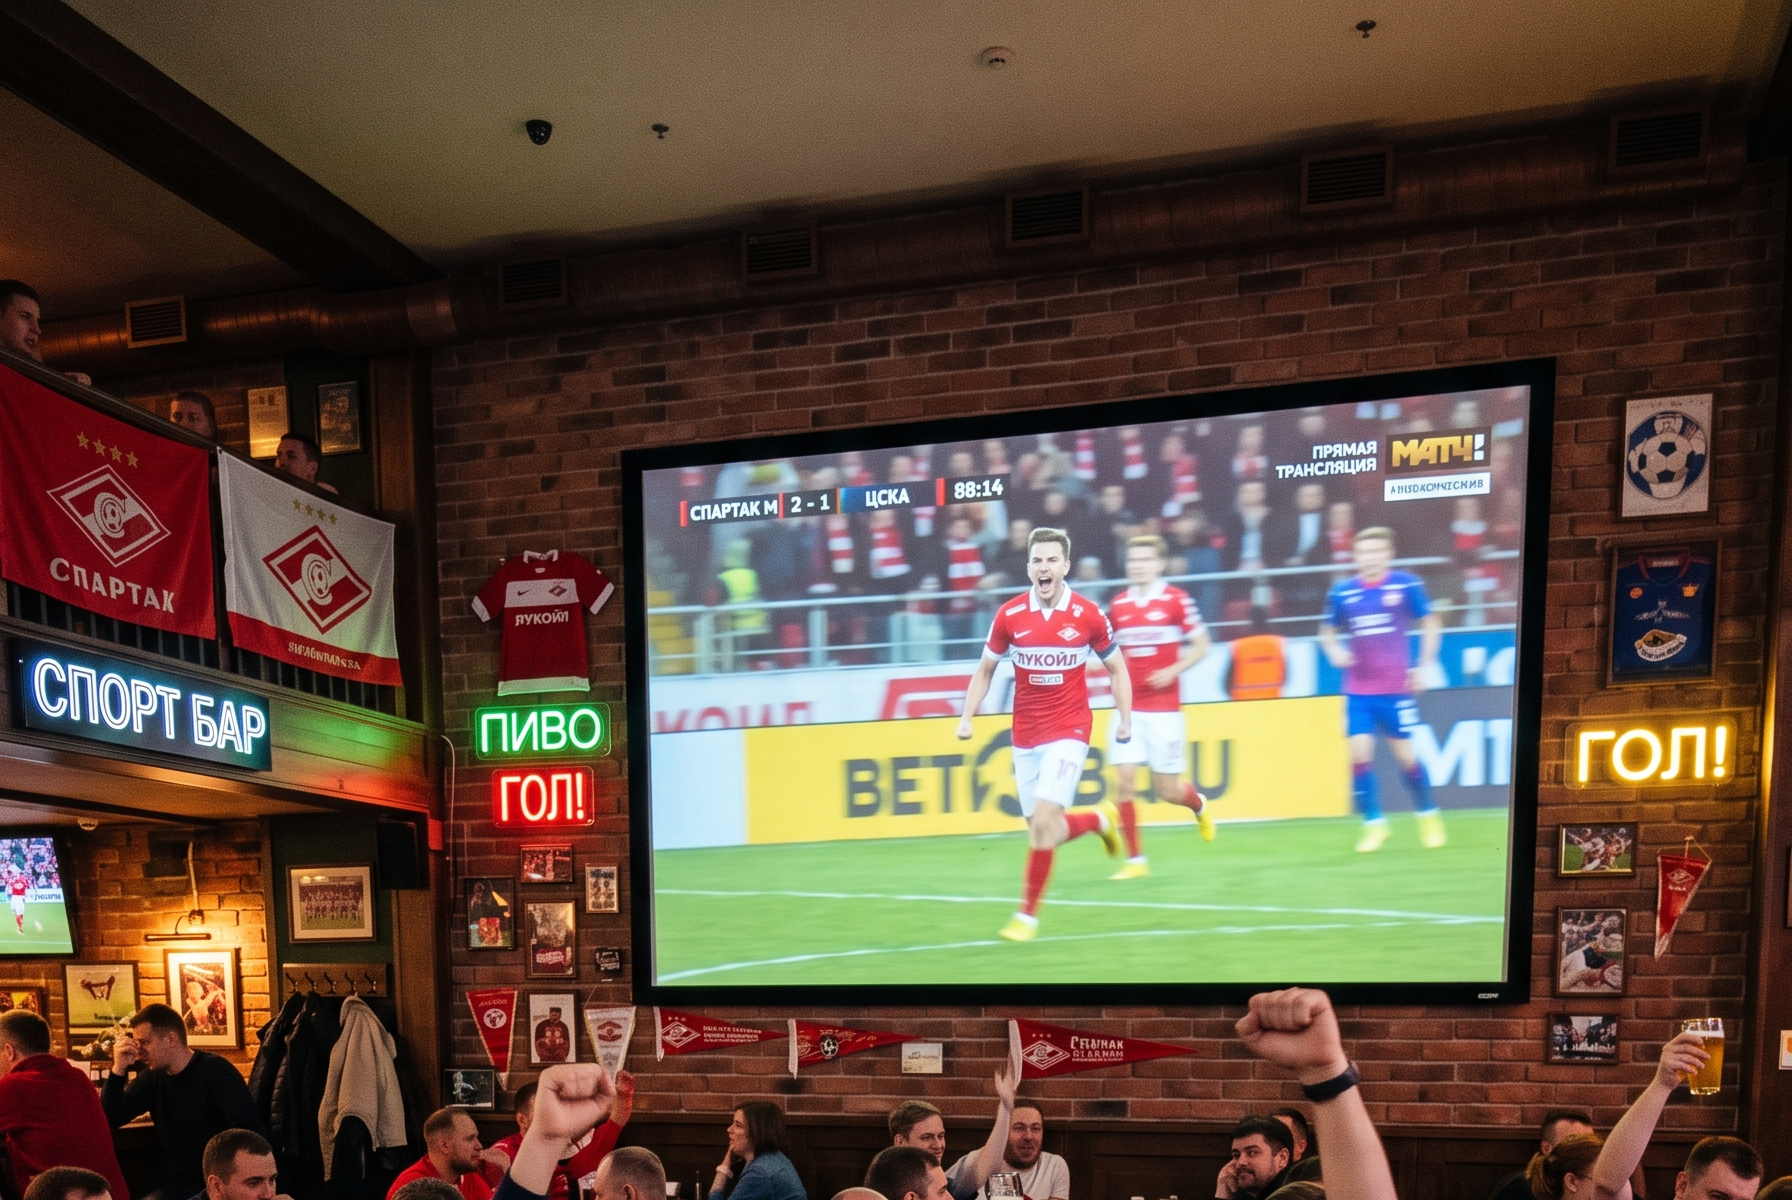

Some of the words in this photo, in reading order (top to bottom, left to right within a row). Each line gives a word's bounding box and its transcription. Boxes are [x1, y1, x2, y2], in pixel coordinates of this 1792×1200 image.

[1312, 441, 1377, 459] ПРЯМАЯ
[1392, 434, 1484, 467] МАТЧ!
[1276, 458, 1377, 479] ТРАНСЛЯЦИЯ
[865, 487, 910, 508] ЦСКА
[954, 479, 1003, 499] 88:14
[690, 500, 761, 522] СПАРТАК
[764, 499, 778, 515] М
[791, 497, 801, 513] 2
[821, 494, 830, 511] 1
[50, 557, 175, 614] СПАРТАК
[34, 659, 181, 740] СПОРТ
[192, 696, 266, 755] БАР
[481, 709, 601, 752] ПИВО
[1578, 726, 1727, 783] ГОЛ!
[500, 772, 585, 822] ГОЛ!
